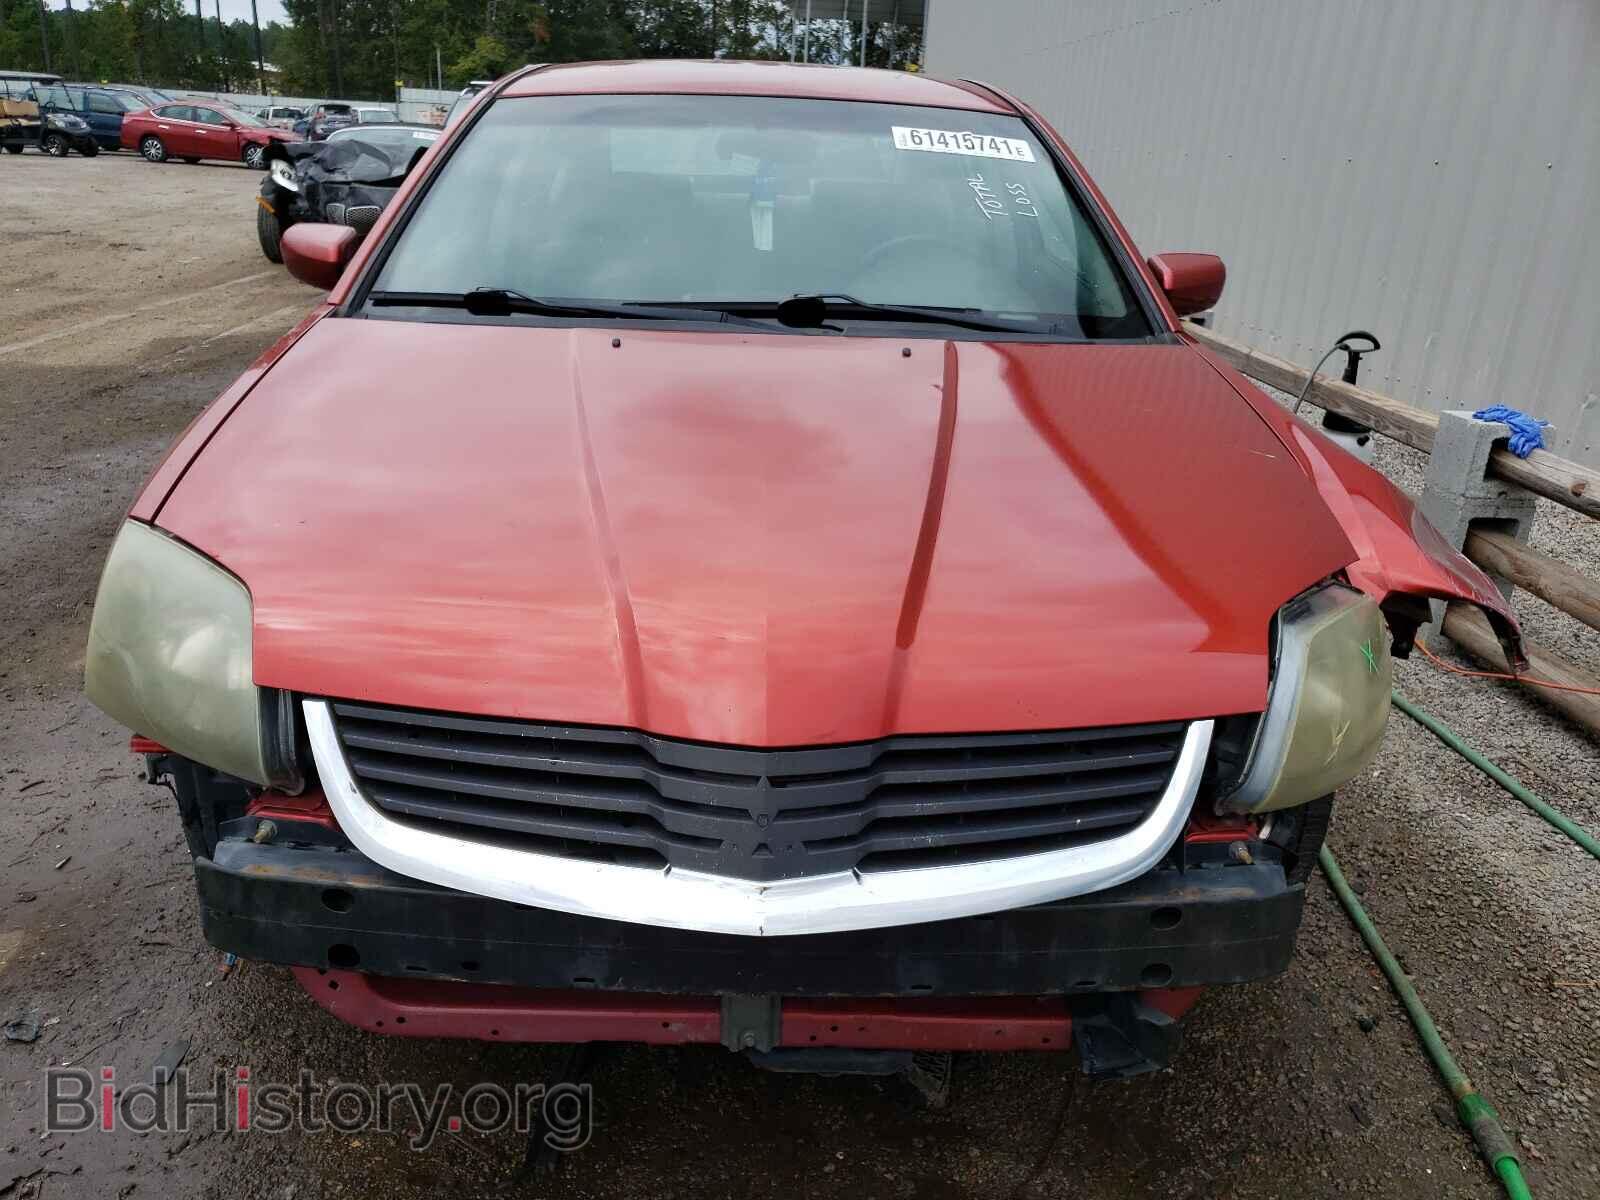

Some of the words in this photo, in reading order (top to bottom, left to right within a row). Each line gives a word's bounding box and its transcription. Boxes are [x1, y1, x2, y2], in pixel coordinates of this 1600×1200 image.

[910, 129, 1013, 156] 61415741
[967, 173, 1008, 221] TOTAL
[1005, 183, 1039, 217] LOSS
